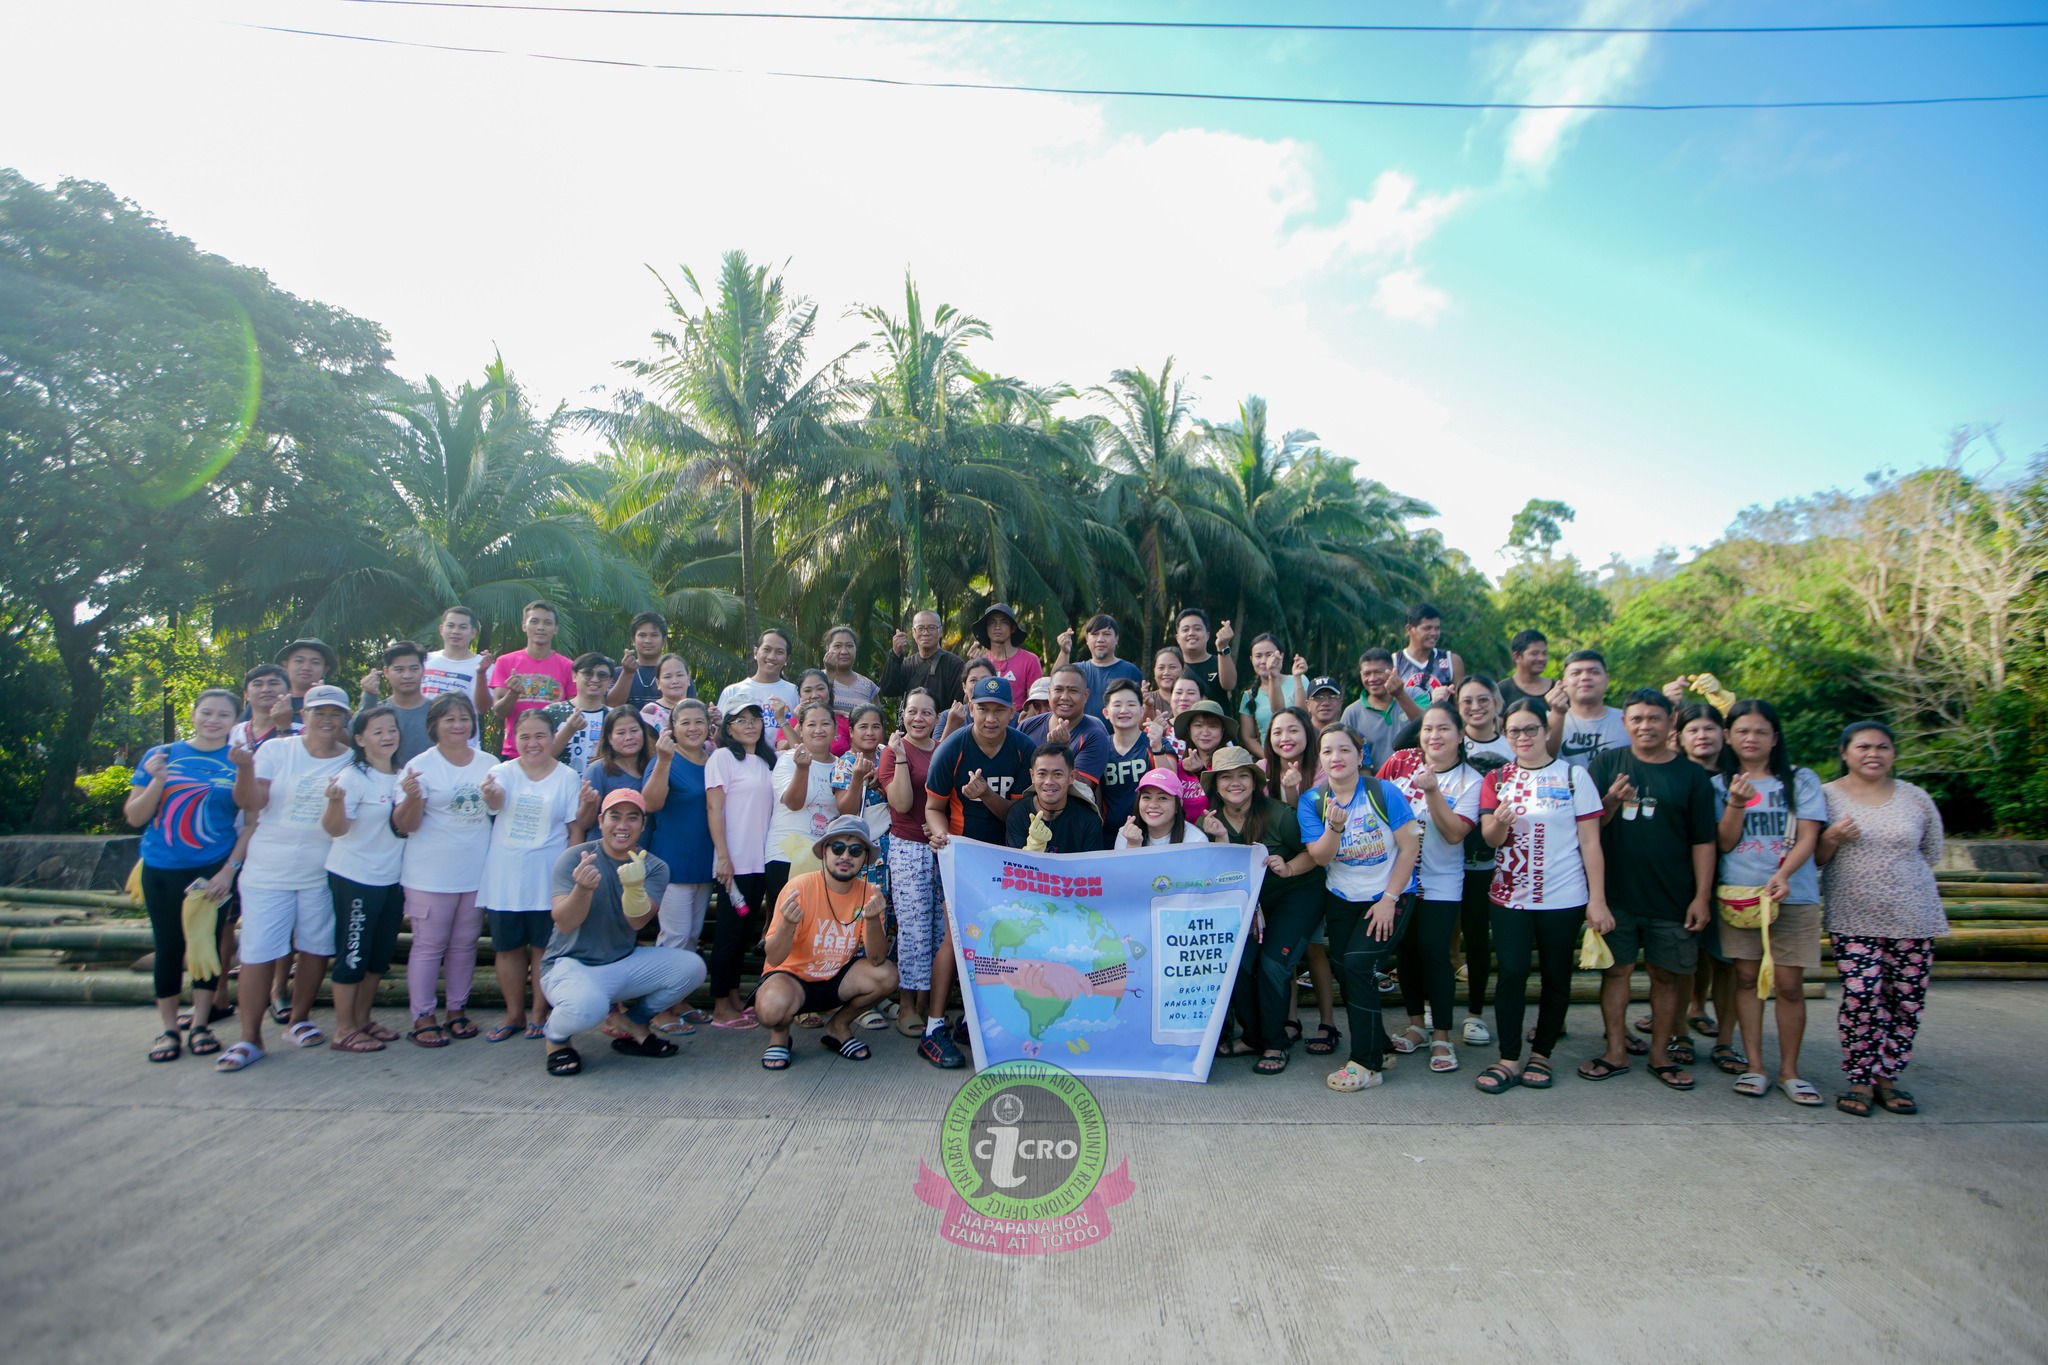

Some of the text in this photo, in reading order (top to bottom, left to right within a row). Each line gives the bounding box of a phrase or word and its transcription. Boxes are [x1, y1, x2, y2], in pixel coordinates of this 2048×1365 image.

[1314, 676, 1330, 686] NY
[1569, 732, 1602, 748] JUST
[1104, 759, 1147, 786] BFP
[1003, 861, 1022, 869] TAYO
[1532, 822, 1545, 904] MAROON CRUSHERS
[1003, 866, 1102, 887] SOLUSYON
[1219, 875, 1243, 883] REYNOSO
[1001, 878, 1103, 897] POLUSYON
[346, 898, 367, 950] adidas
[817, 918, 857, 937] YAW
[1188, 918, 1214, 931] 4TH
[813, 934, 857, 949] FREE
[1166, 932, 1234, 947] QUARTER
[1180, 948, 1222, 962] RIVER
[1164, 962, 1228, 977] CLEAN-U
[1179, 986, 1203, 994] BRGY.
[1164, 999, 1197, 1007] NANGKA
[1169, 1012, 1189, 1020] NOV.
